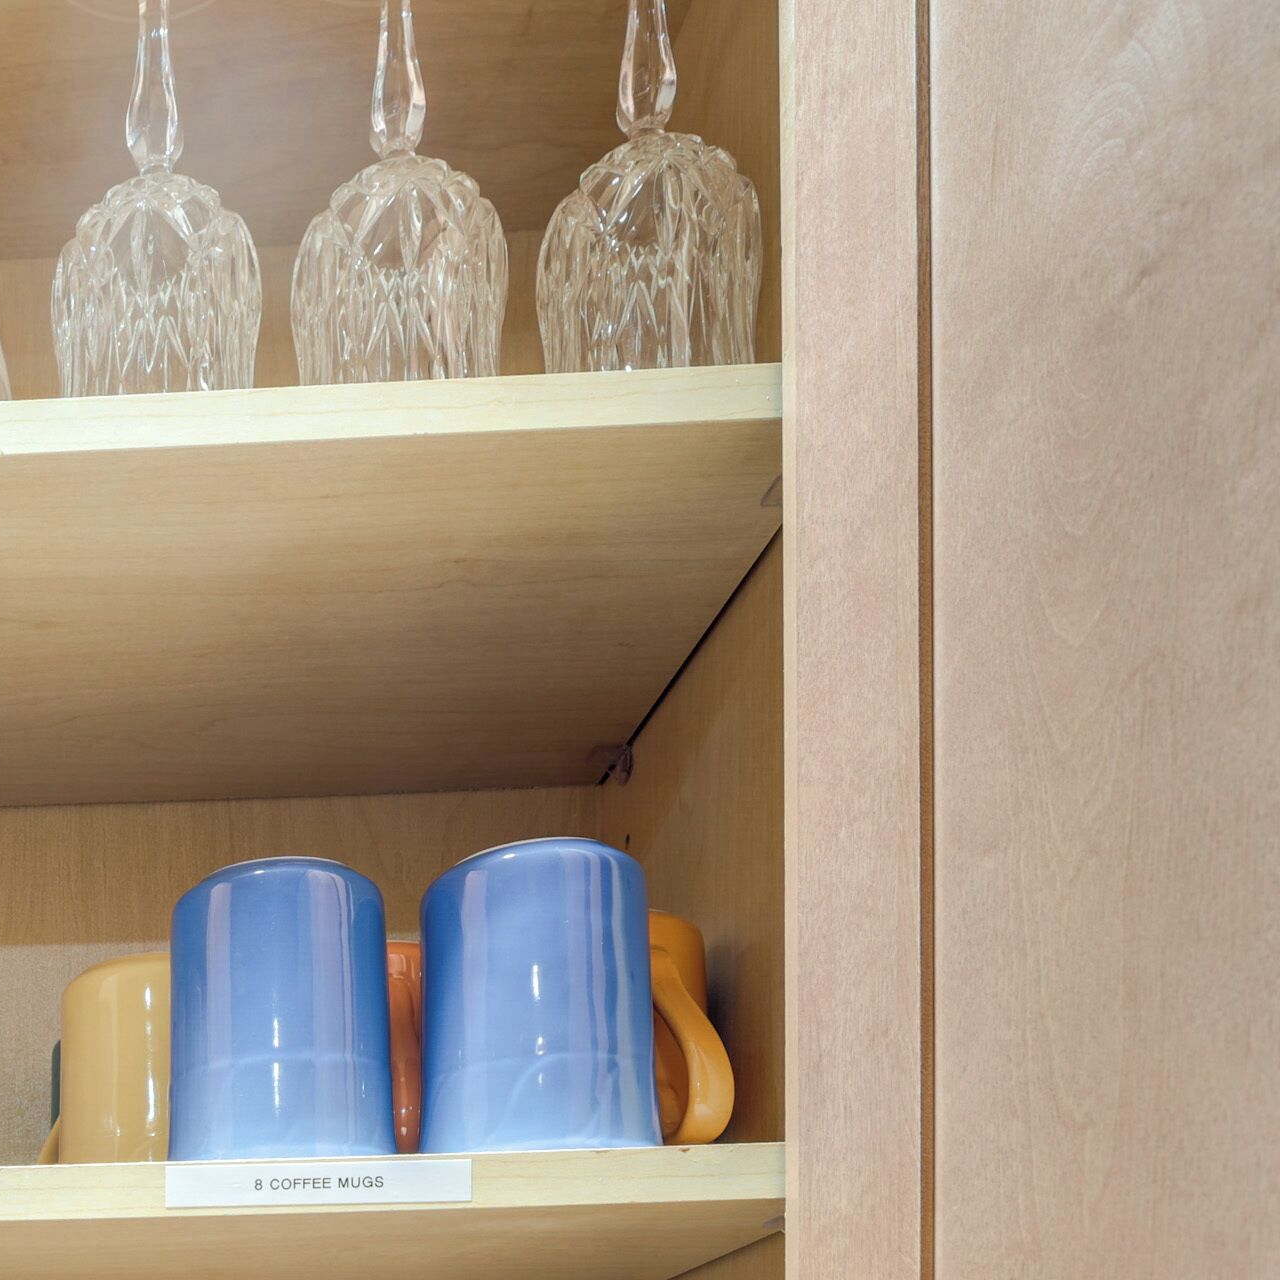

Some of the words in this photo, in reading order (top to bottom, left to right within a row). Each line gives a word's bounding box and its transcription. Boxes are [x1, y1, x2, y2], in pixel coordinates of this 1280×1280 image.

[254, 1178, 263, 1191] 8
[270, 1177, 332, 1190] COFFEE
[338, 1176, 384, 1189] MUGS
